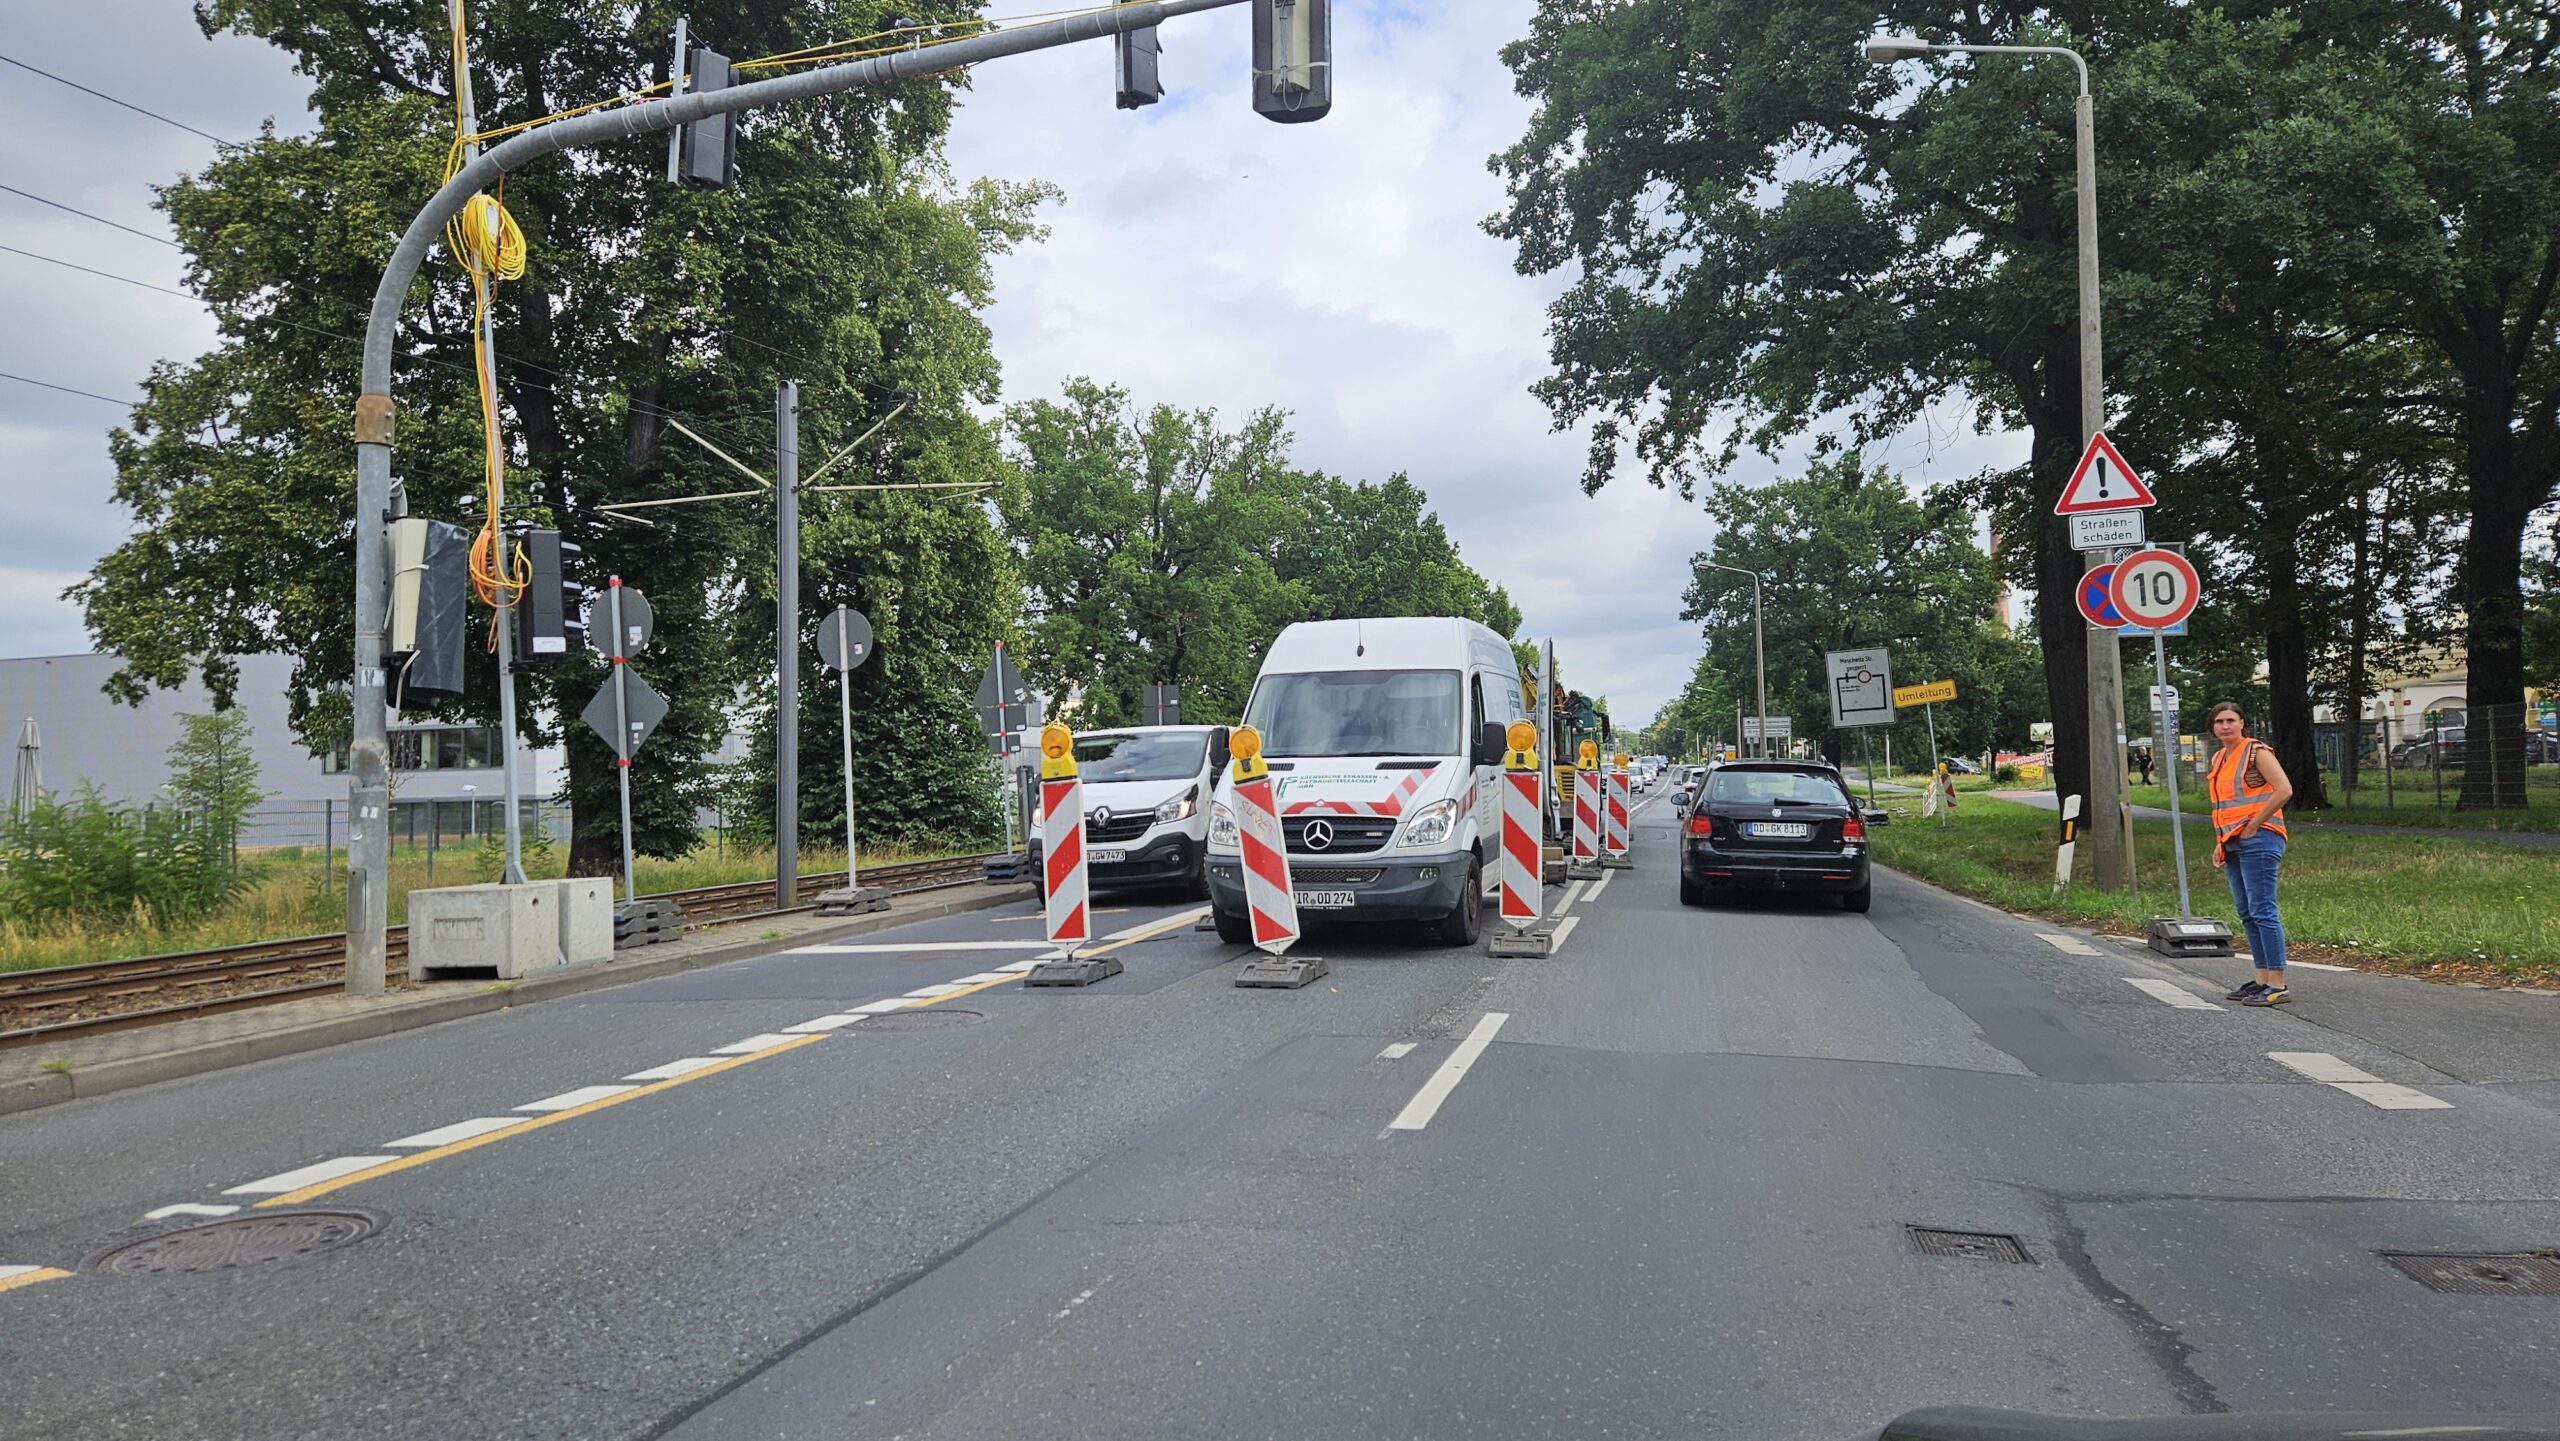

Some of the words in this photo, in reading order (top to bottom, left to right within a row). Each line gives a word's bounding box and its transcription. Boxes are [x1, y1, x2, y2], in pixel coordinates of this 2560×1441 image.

[2080, 518, 2133, 530] Straßen-
[2083, 532, 2132, 543] schäden
[2133, 571, 2176, 607] 10
[1898, 687, 1951, 702] Umleitung
[1753, 823, 1765, 833] DD
[1771, 824, 1783, 833] GK
[1784, 824, 1806, 834] 8113
[1294, 892, 1309, 905] IR
[1333, 892, 1353, 905] 274
